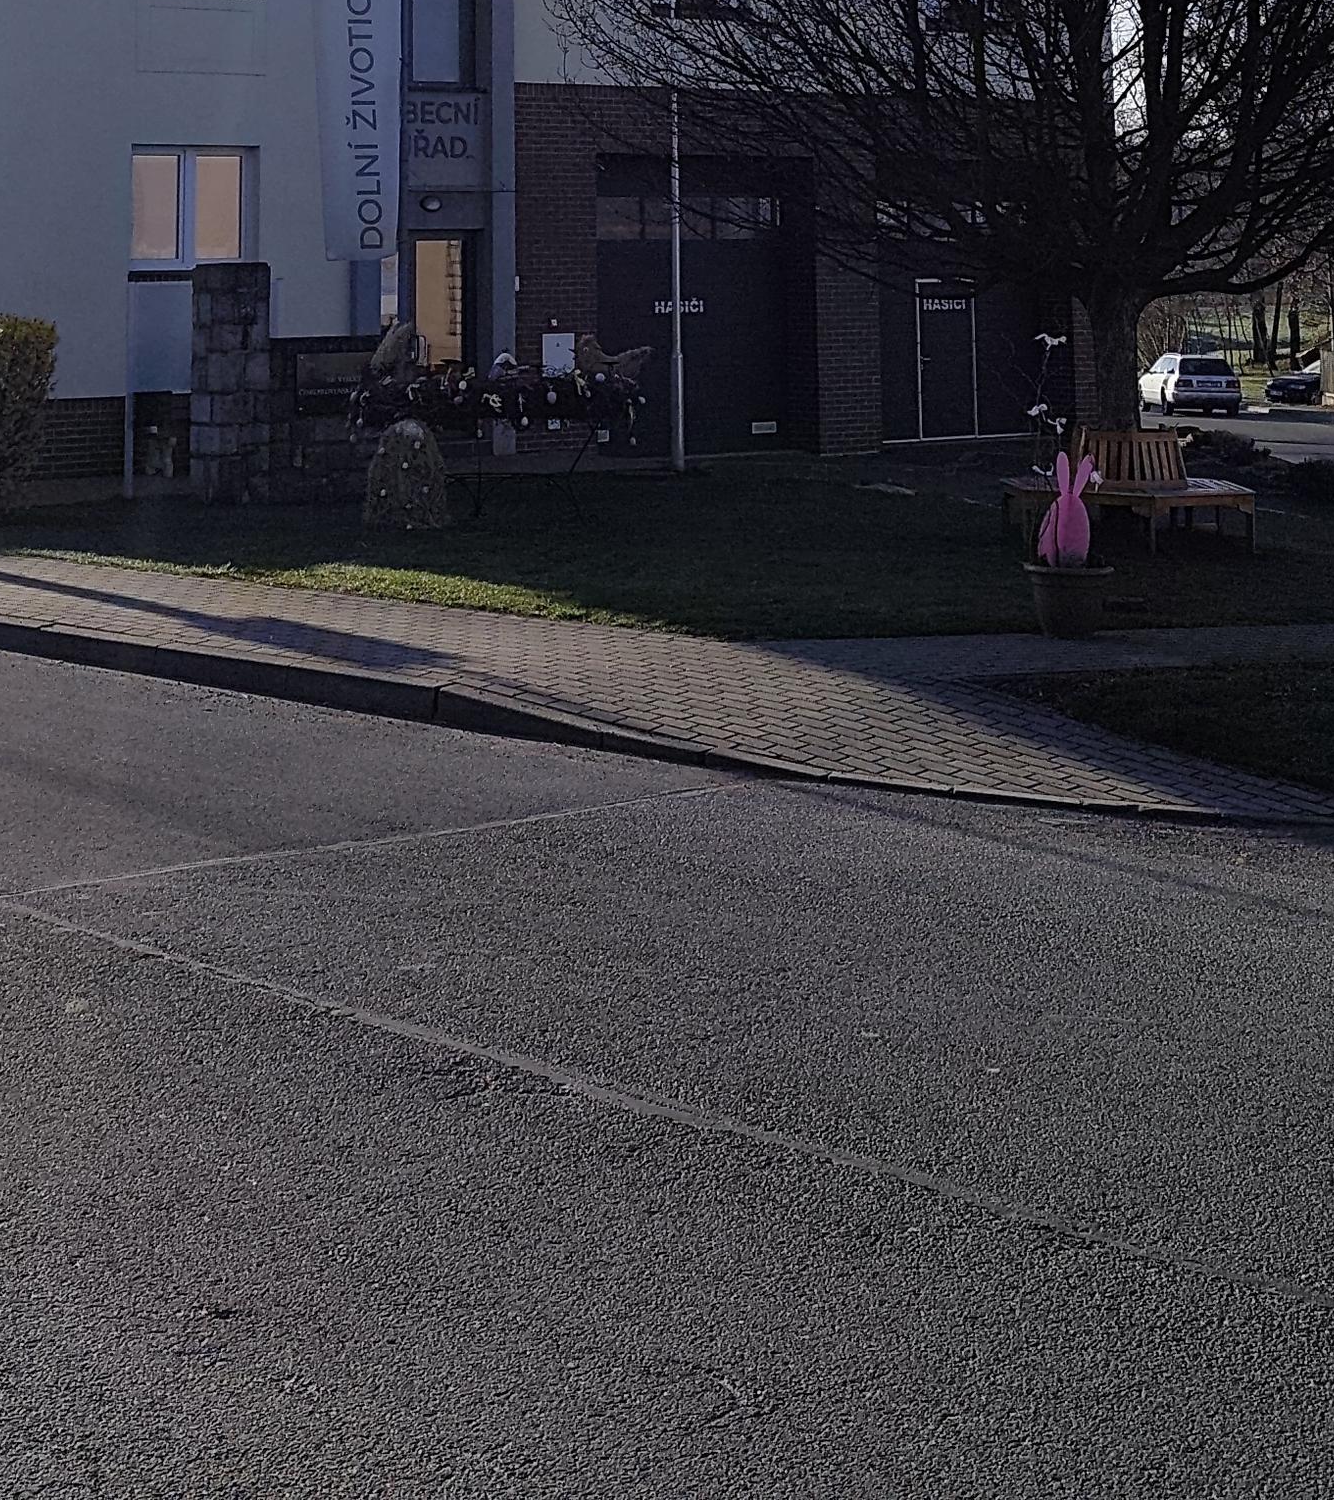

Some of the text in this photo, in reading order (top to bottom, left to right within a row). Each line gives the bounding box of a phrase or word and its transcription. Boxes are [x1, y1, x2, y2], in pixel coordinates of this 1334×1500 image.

[405, 97, 481, 124] BECNÍ
[407, 128, 468, 159] ŘAD
[347, 141, 384, 250] DOLNÍ
